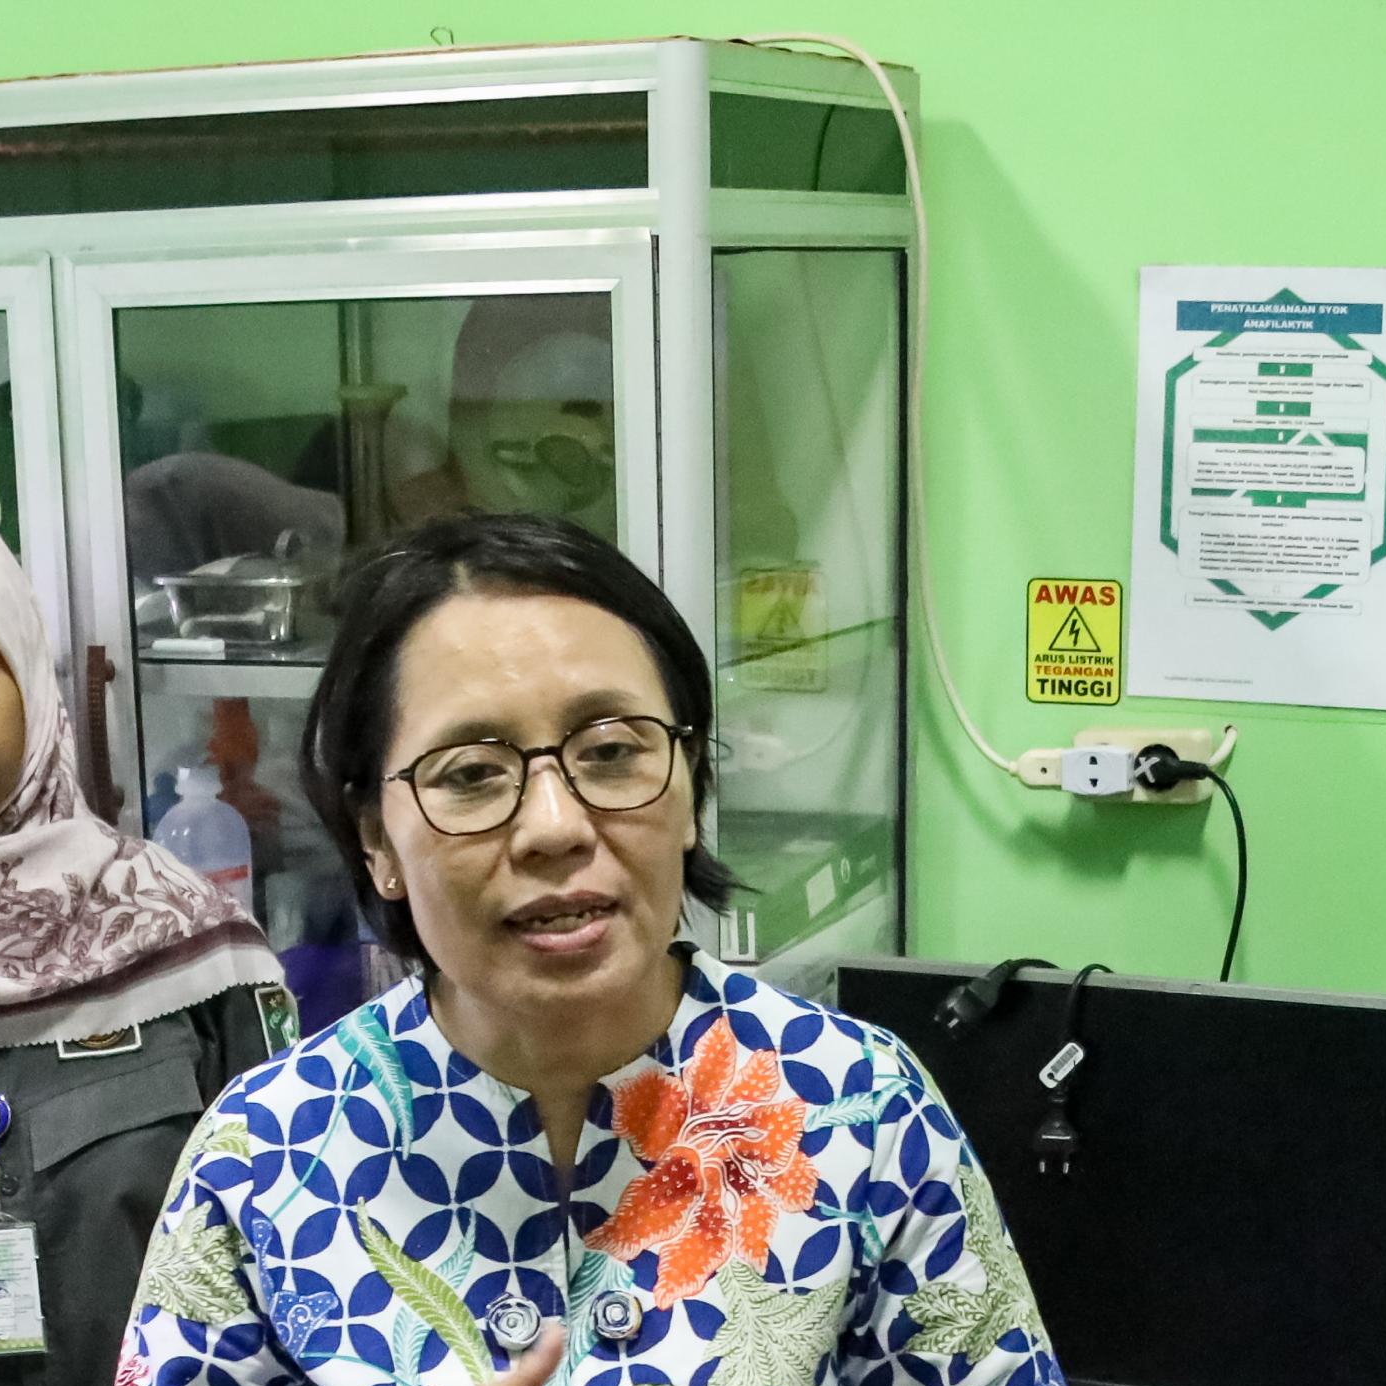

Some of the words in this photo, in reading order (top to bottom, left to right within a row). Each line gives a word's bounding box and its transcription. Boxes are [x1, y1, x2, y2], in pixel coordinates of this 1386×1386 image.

[1211, 303, 1316, 314] PENATALAKSANAAN
[1318, 305, 1349, 315] SYOK
[1243, 319, 1314, 330] ANAFILAKTIK
[1034, 584, 1116, 606] AWAS
[1034, 654, 1066, 663] ARUS
[1069, 655, 1114, 665] LISTRIK
[1036, 665, 1114, 677] TEGANGAN
[1036, 678, 1112, 697] TINGGI
